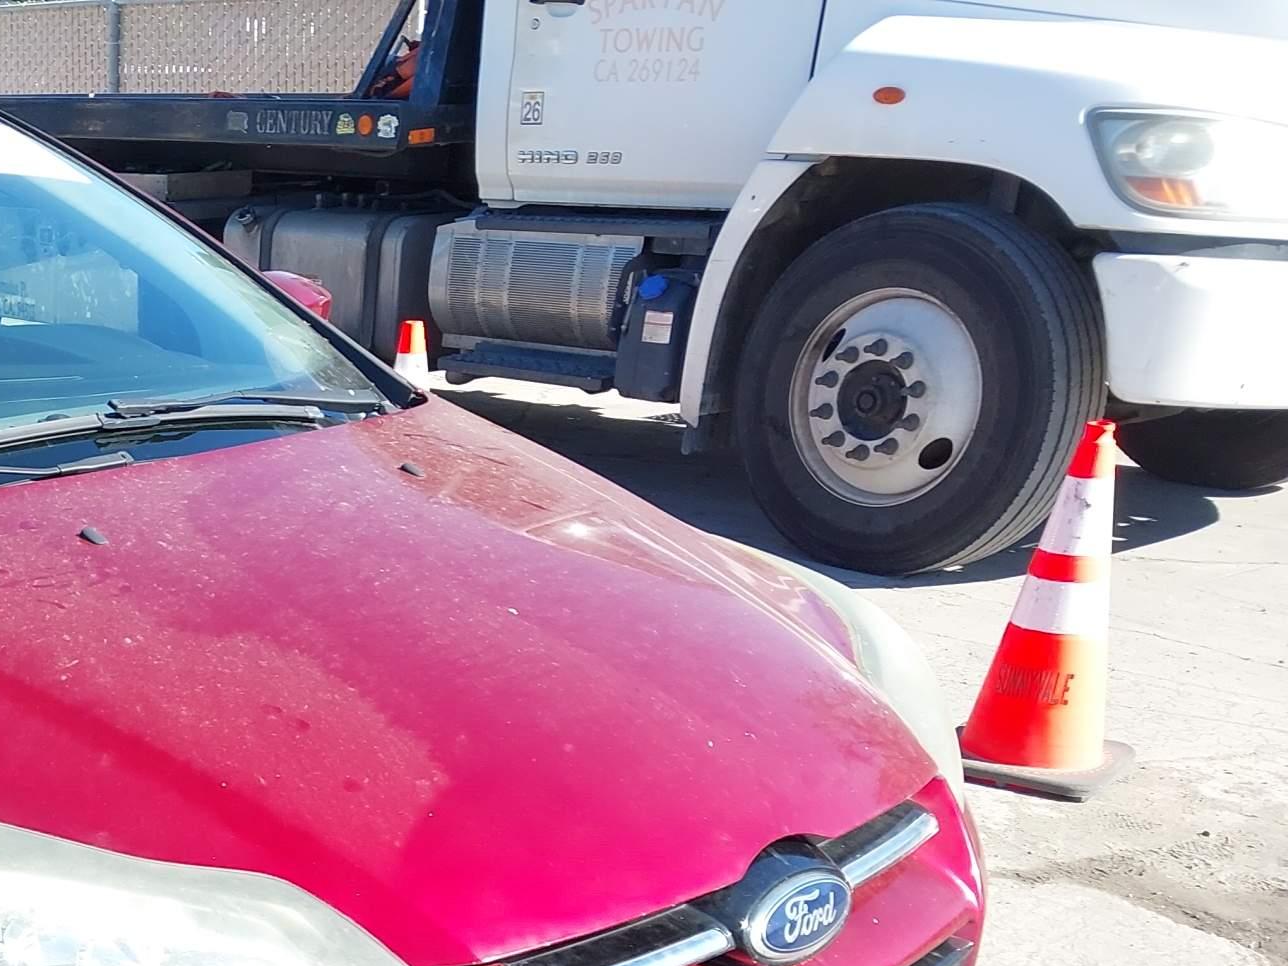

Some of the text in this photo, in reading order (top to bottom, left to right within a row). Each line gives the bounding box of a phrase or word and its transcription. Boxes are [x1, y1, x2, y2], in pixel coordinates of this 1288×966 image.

[599, 26, 705, 53] TOWING
[593, 57, 701, 83] CA 269124
[256, 110, 333, 136] CENTURY
[523, 101, 541, 122] 26
[517, 150, 579, 165] HINO
[784, 889, 837, 944] Ford
